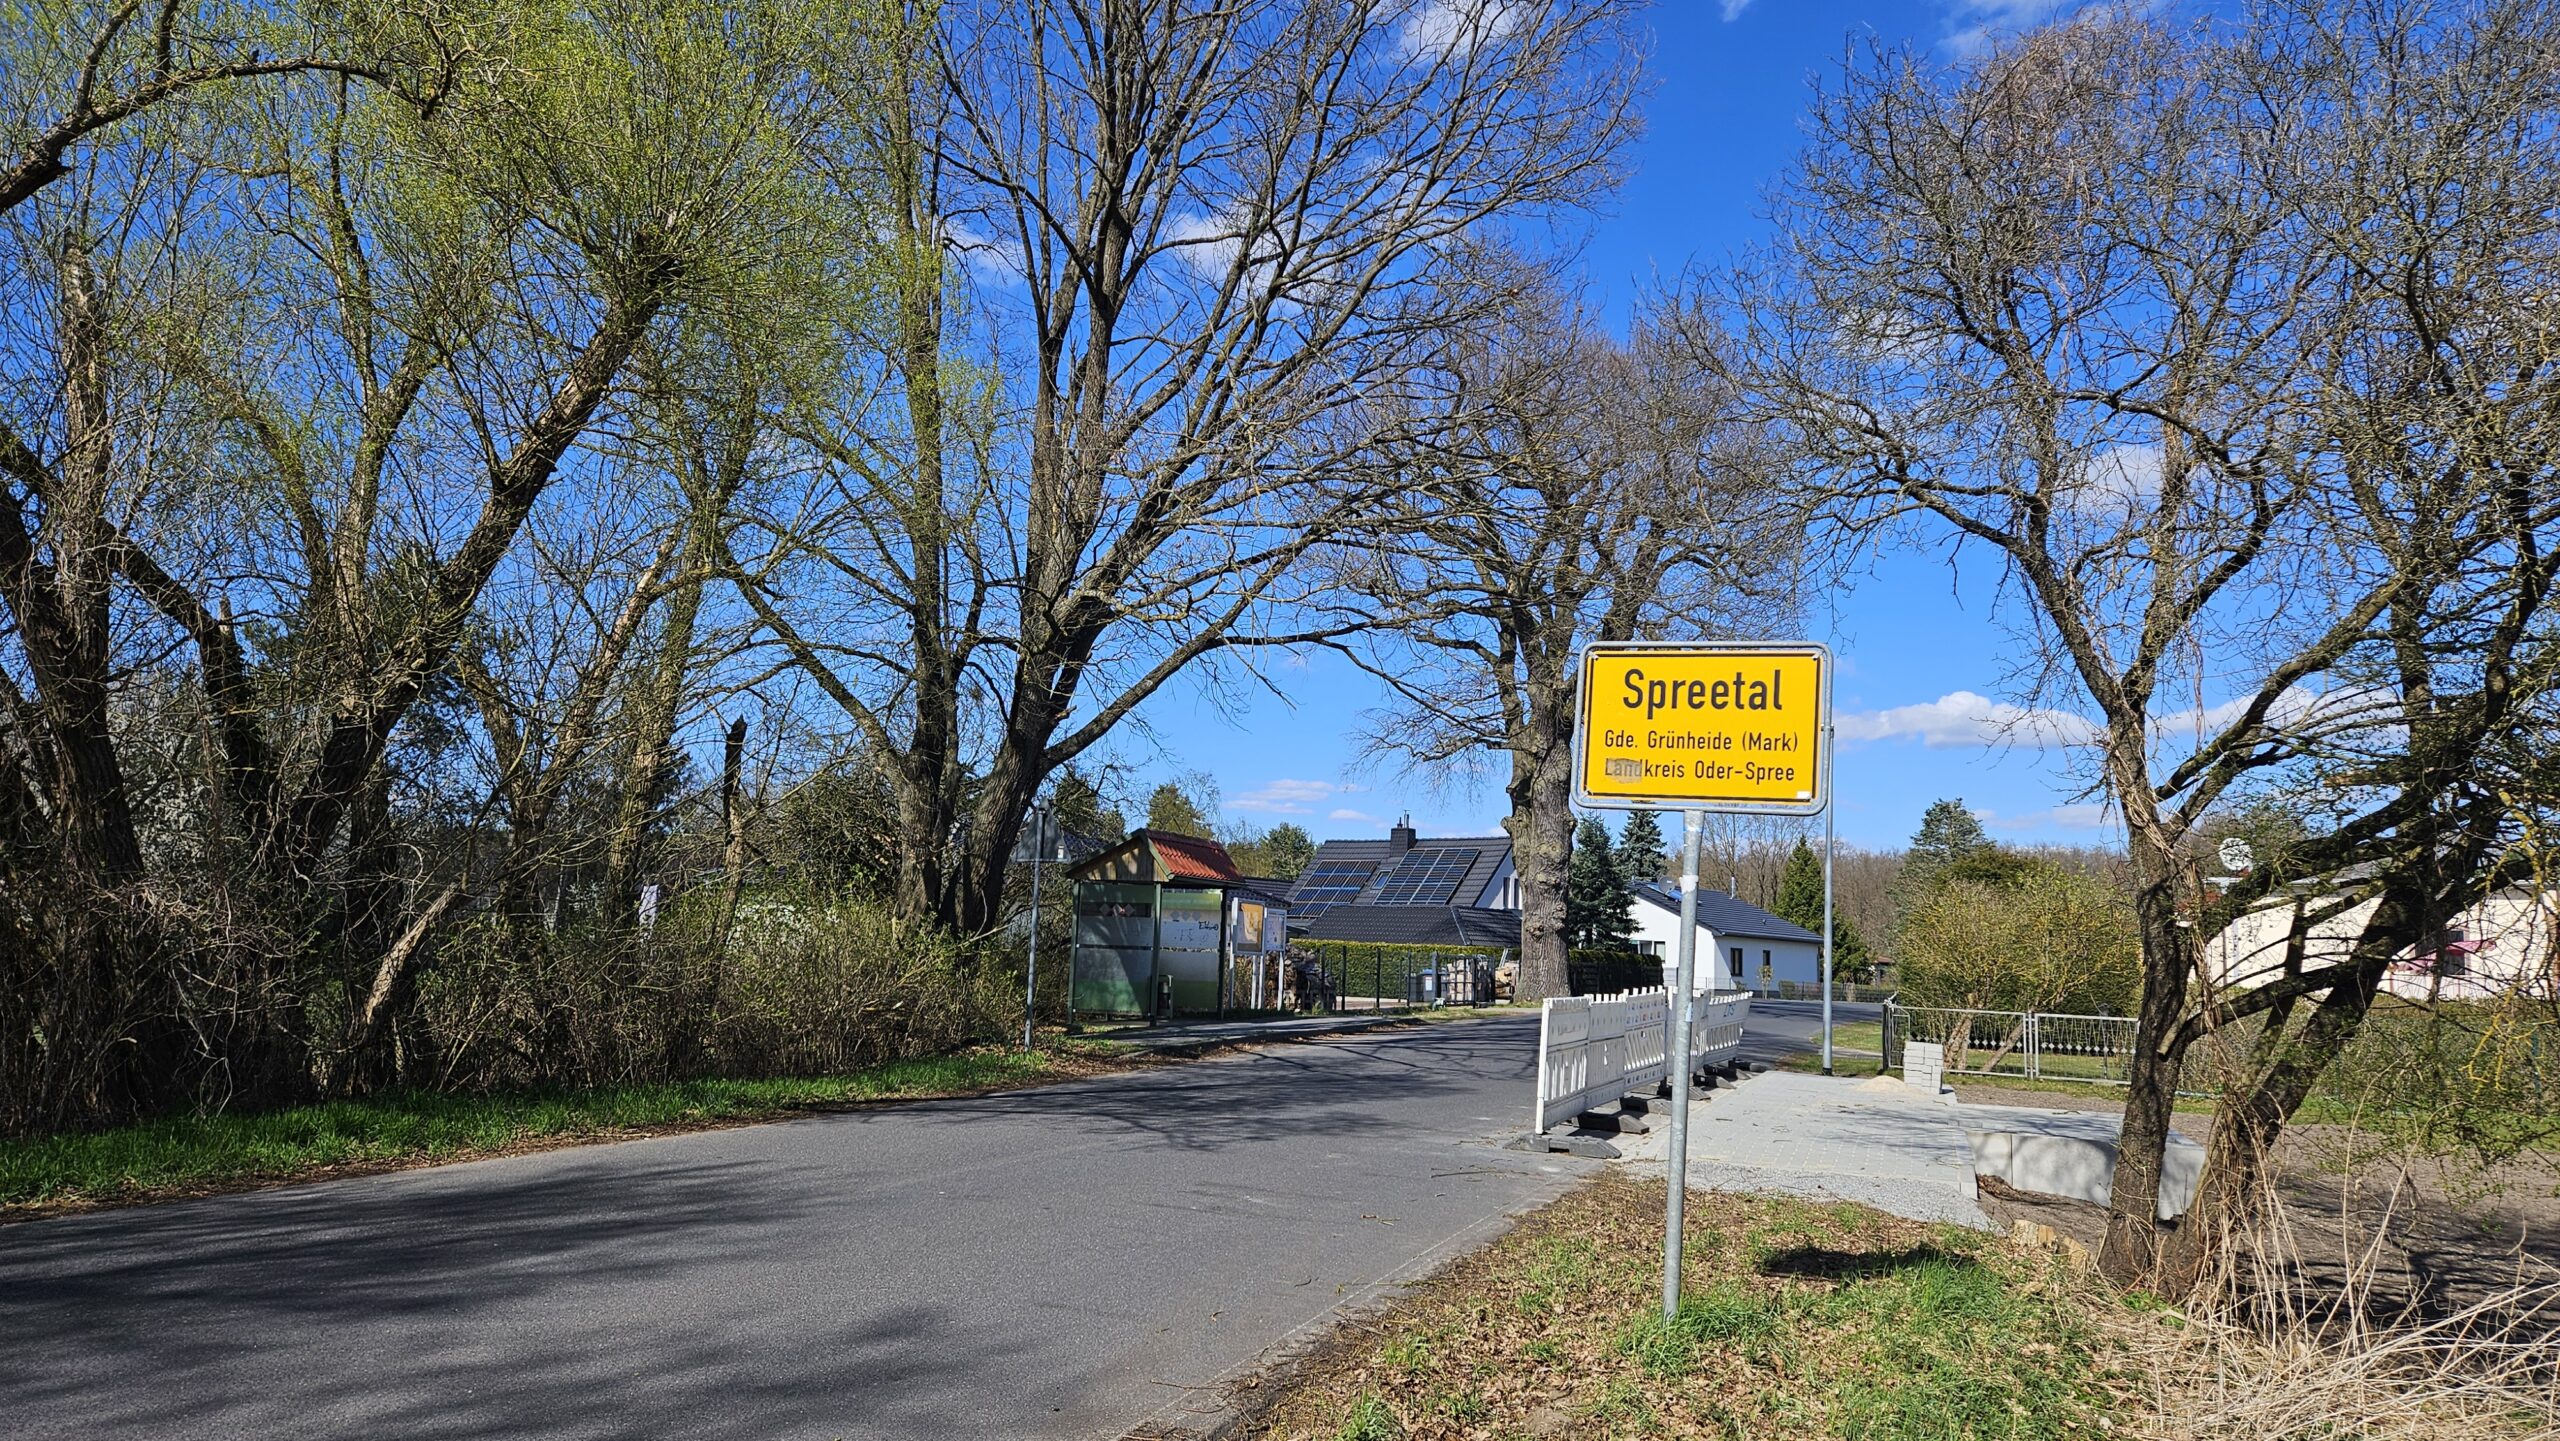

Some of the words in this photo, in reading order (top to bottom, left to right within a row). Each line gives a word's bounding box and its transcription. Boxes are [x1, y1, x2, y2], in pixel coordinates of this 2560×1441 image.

[1623, 669, 1782, 720] Spreetal
[1605, 730, 1638, 748] Gde.
[1648, 731, 1732, 750] Grünheide
[1742, 732, 1798, 752] (Mark)
[1605, 758, 1685, 778] Landkreis
[1695, 761, 1795, 785] Oder-Spree
